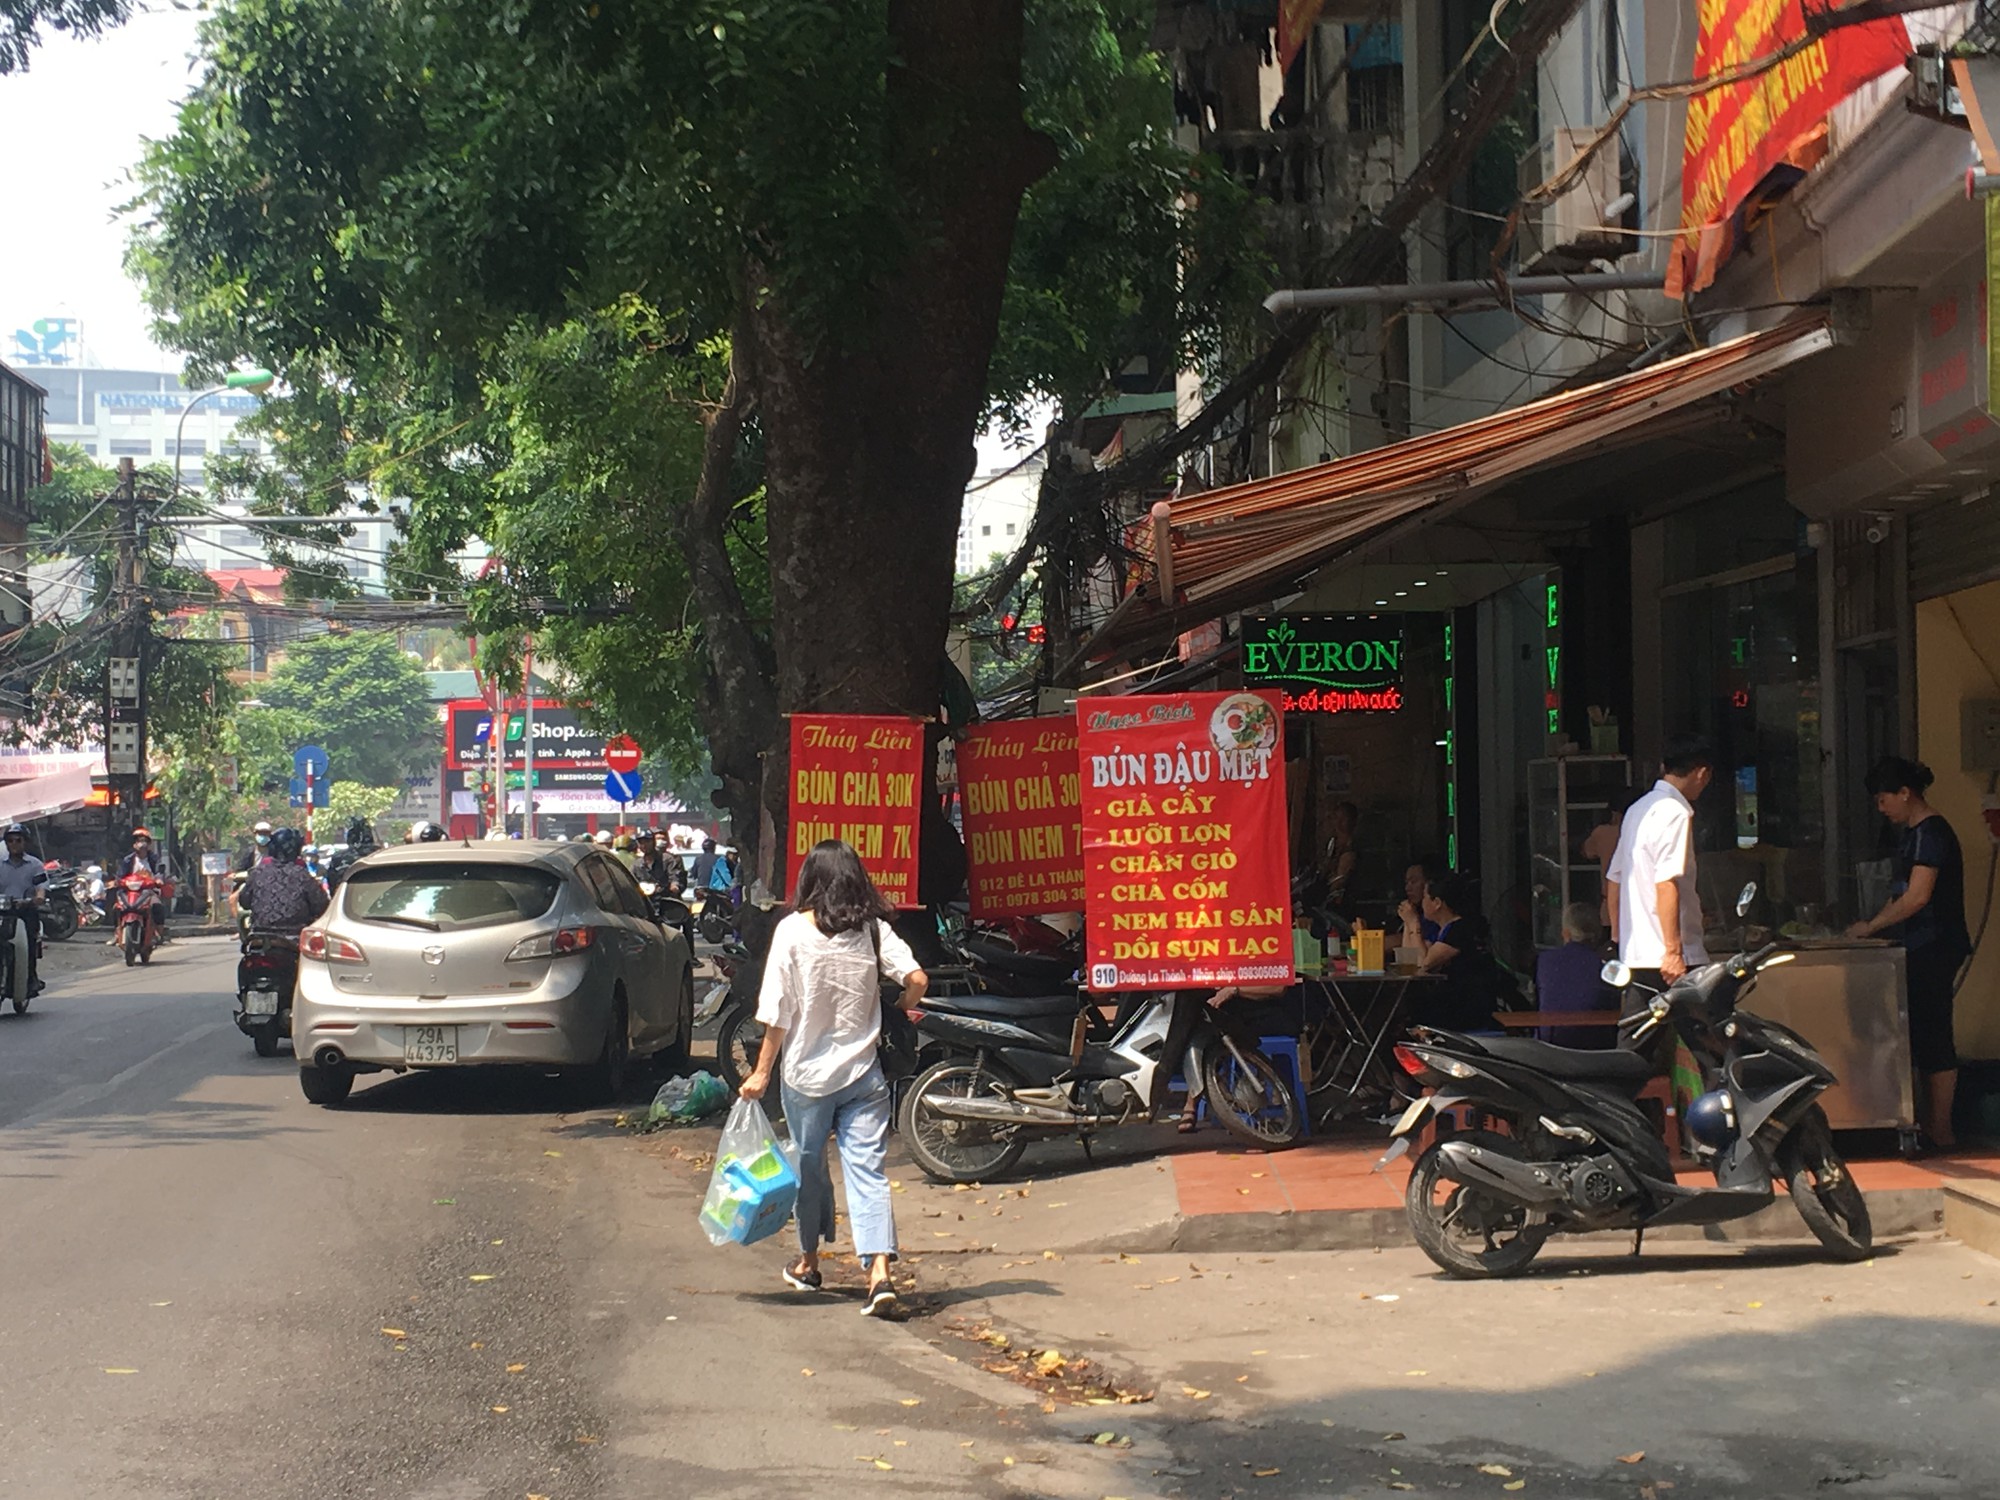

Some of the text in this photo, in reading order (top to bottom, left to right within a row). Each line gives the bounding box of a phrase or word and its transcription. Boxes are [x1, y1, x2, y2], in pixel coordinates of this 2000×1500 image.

[100, 394, 183, 408] NATIONAL
[1244, 640, 1400, 673] EVERON
[1348, 690, 1369, 709] HÀN
[1370, 687, 1401, 709] QUỐC
[802, 725, 913, 753] Thúy Liên
[1031, 731, 1079, 753] Liên
[564, 748, 592, 759] Apple
[1091, 741, 1273, 791] BÚN ĐẬU MẸT
[554, 773, 585, 781] SAMSUNG
[797, 757, 915, 808] BÚN CHẢ 30K
[967, 760, 1083, 816] BÚN CHẢ 30
[1107, 788, 1217, 818] GIẢ CẦY
[840, 823, 884, 859] NEM
[893, 825, 912, 859] 7K
[972, 824, 1014, 865] BÚN
[1018, 824, 1065, 861] NEM
[1179, 822, 1232, 847] LỢN
[1110, 847, 1238, 874] CHÂN GIÒ
[980, 876, 1004, 892] 912
[1029, 873, 1047, 887] LA
[1111, 874, 1229, 902] CHẢ CỐM
[1006, 892, 1039, 908] 0978
[1043, 889, 1068, 904] 304
[1112, 902, 1284, 931] NEM HẢI SẢN
[1113, 932, 1280, 962] DỒI SỤN LẠC
[1095, 968, 1115, 984] 910
[1148, 969, 1159, 983] La
[417, 1027, 444, 1044] 29A
